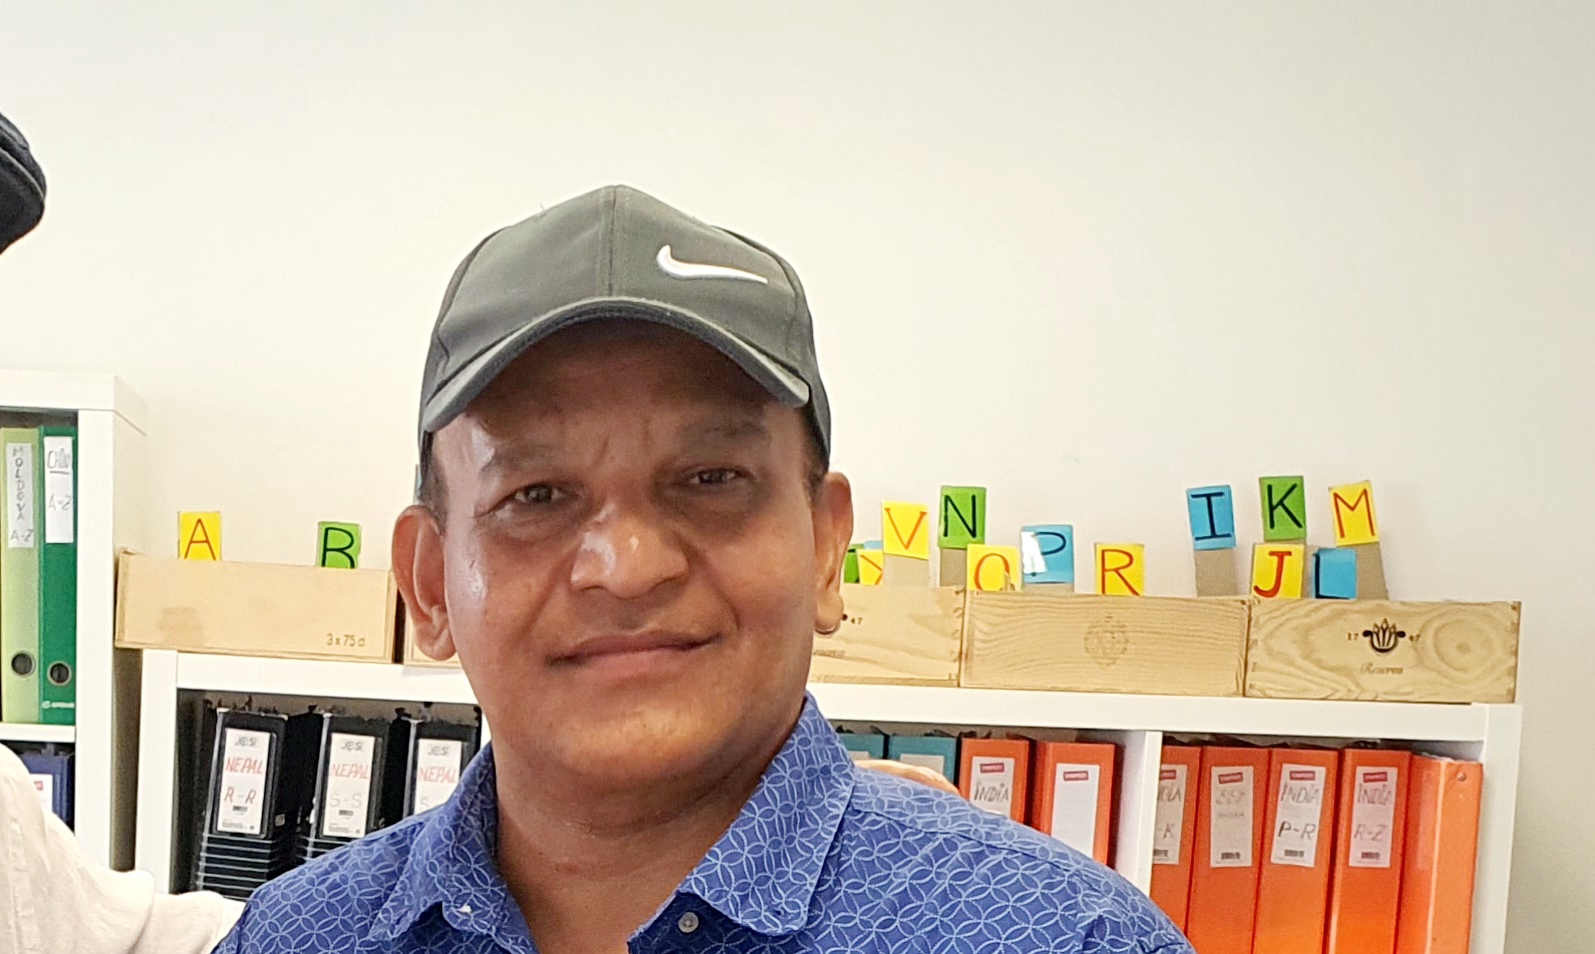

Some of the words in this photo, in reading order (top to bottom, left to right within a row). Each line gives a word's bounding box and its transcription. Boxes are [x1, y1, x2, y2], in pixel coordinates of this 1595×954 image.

[943, 494, 977, 539] N
[1191, 491, 1233, 541] I
[1267, 483, 1303, 530] K
[1333, 488, 1376, 539] M
[184, 518, 217, 561] A
[884, 507, 928, 550] V
[1031, 531, 1067, 578] P
[1101, 549, 1140, 597] R
[1252, 550, 1293, 598] J
[326, 633, 334, 647] 3
[343, 634, 356, 648] 75
[226, 756, 264, 775] NEPAL
[331, 762, 369, 780] NEPAL
[419, 766, 457, 784] NEPAL
[223, 786, 257, 805] R-R
[1277, 821, 1317, 841] P-R
